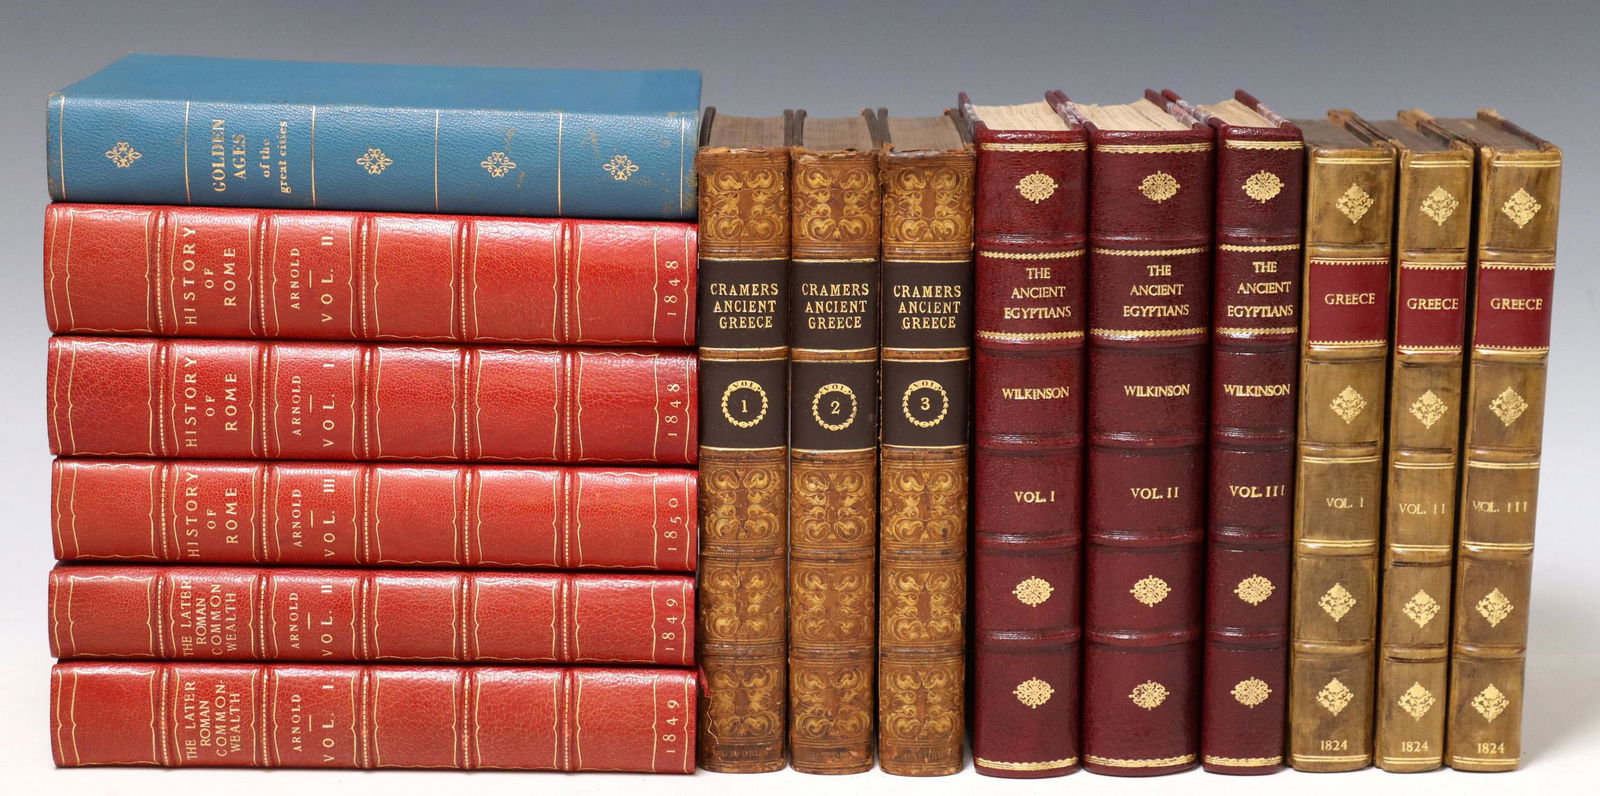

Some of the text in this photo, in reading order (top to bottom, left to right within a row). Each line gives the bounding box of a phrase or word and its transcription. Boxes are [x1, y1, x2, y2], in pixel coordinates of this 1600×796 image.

[211, 118, 226, 192] GOLDEN
[233, 133, 246, 179] AGES
[258, 138, 270, 178] of the
[278, 121, 292, 193] great cities
[182, 227, 197, 325] HISTORY
[1026, 267, 1051, 280] THE
[1147, 265, 1172, 277] THE
[1253, 261, 1278, 274] THE
[204, 268, 214, 289] OF
[224, 247, 237, 307] ROME
[290, 248, 300, 310] ARNOLD
[321, 268, 334, 322] VOL.
[664, 260, 681, 316] 1848
[710, 283, 779, 296] CRAMERS
[801, 283, 870, 296] CRAMERS
[893, 285, 962, 298] CRAMERS
[1011, 286, 1066, 299] ANCIENT
[1130, 284, 1184, 296] ANCIENT
[1237, 282, 1292, 294] ANCIENT
[713, 300, 777, 313] ANCIENT
[804, 300, 868, 314] ANCIENT
[898, 301, 961, 314] ANCIENT
[1324, 293, 1376, 305] GREECE
[1407, 298, 1459, 310] GREECE
[1490, 298, 1543, 310] GREECE
[1004, 306, 1072, 319] EGYPTIANS
[1123, 304, 1190, 317] EGYPTIANS
[1227, 305, 1294, 318] EGYPTIANS
[719, 316, 773, 329] GREECE
[808, 316, 862, 329] GREECE
[902, 316, 956, 330] GREECE
[1002, 386, 1070, 400] WILKINSON
[1124, 384, 1191, 398] WILKINSON
[1224, 383, 1291, 398] WILKINSON
[184, 356, 198, 448] HISTORY
[205, 394, 216, 417] OF
[225, 373, 238, 432] ROME
[292, 375, 302, 436] ARNOLD
[664, 383, 682, 437] 1848
[741, 400, 748, 413] 1
[830, 401, 840, 414] 2
[920, 397, 931, 410] 3
[322, 394, 335, 448] VOL.
[1014, 490, 1055, 503] VOL. I
[1131, 487, 1179, 500] VOL. II
[1230, 485, 1286, 498] VOL. III
[1326, 497, 1364, 509] VOL. I
[1399, 503, 1446, 515] VOL. II
[1472, 502, 1528, 513] VOL. III
[185, 471, 200, 558] HISTORY
[206, 508, 217, 530] OF
[226, 487, 239, 544] ROME
[292, 488, 302, 547] ARNOLD
[664, 497, 682, 551] 1850
[323, 510, 336, 558] VOL.
[180, 579, 193, 657] THE LATER
[196, 597, 207, 645] ROMAN
[211, 583, 223, 656] COMMON
[226, 592, 237, 652] WEALTH
[290, 592, 300, 649] ARNOLD
[661, 598, 679, 651] 1849
[321, 610, 334, 657] VOL.
[183, 681, 198, 761] THE LATER
[200, 700, 211, 748] ROMAN
[215, 679, 226, 757] COMMON-
[230, 692, 241, 753] WEALTH
[291, 694, 302, 752] ARNOLD
[662, 700, 680, 753] 1849
[322, 713, 335, 763] VOL.
[1320, 740, 1348, 751] 1824
[1401, 741, 1430, 752] 1824
[1477, 743, 1505, 754] 1824
